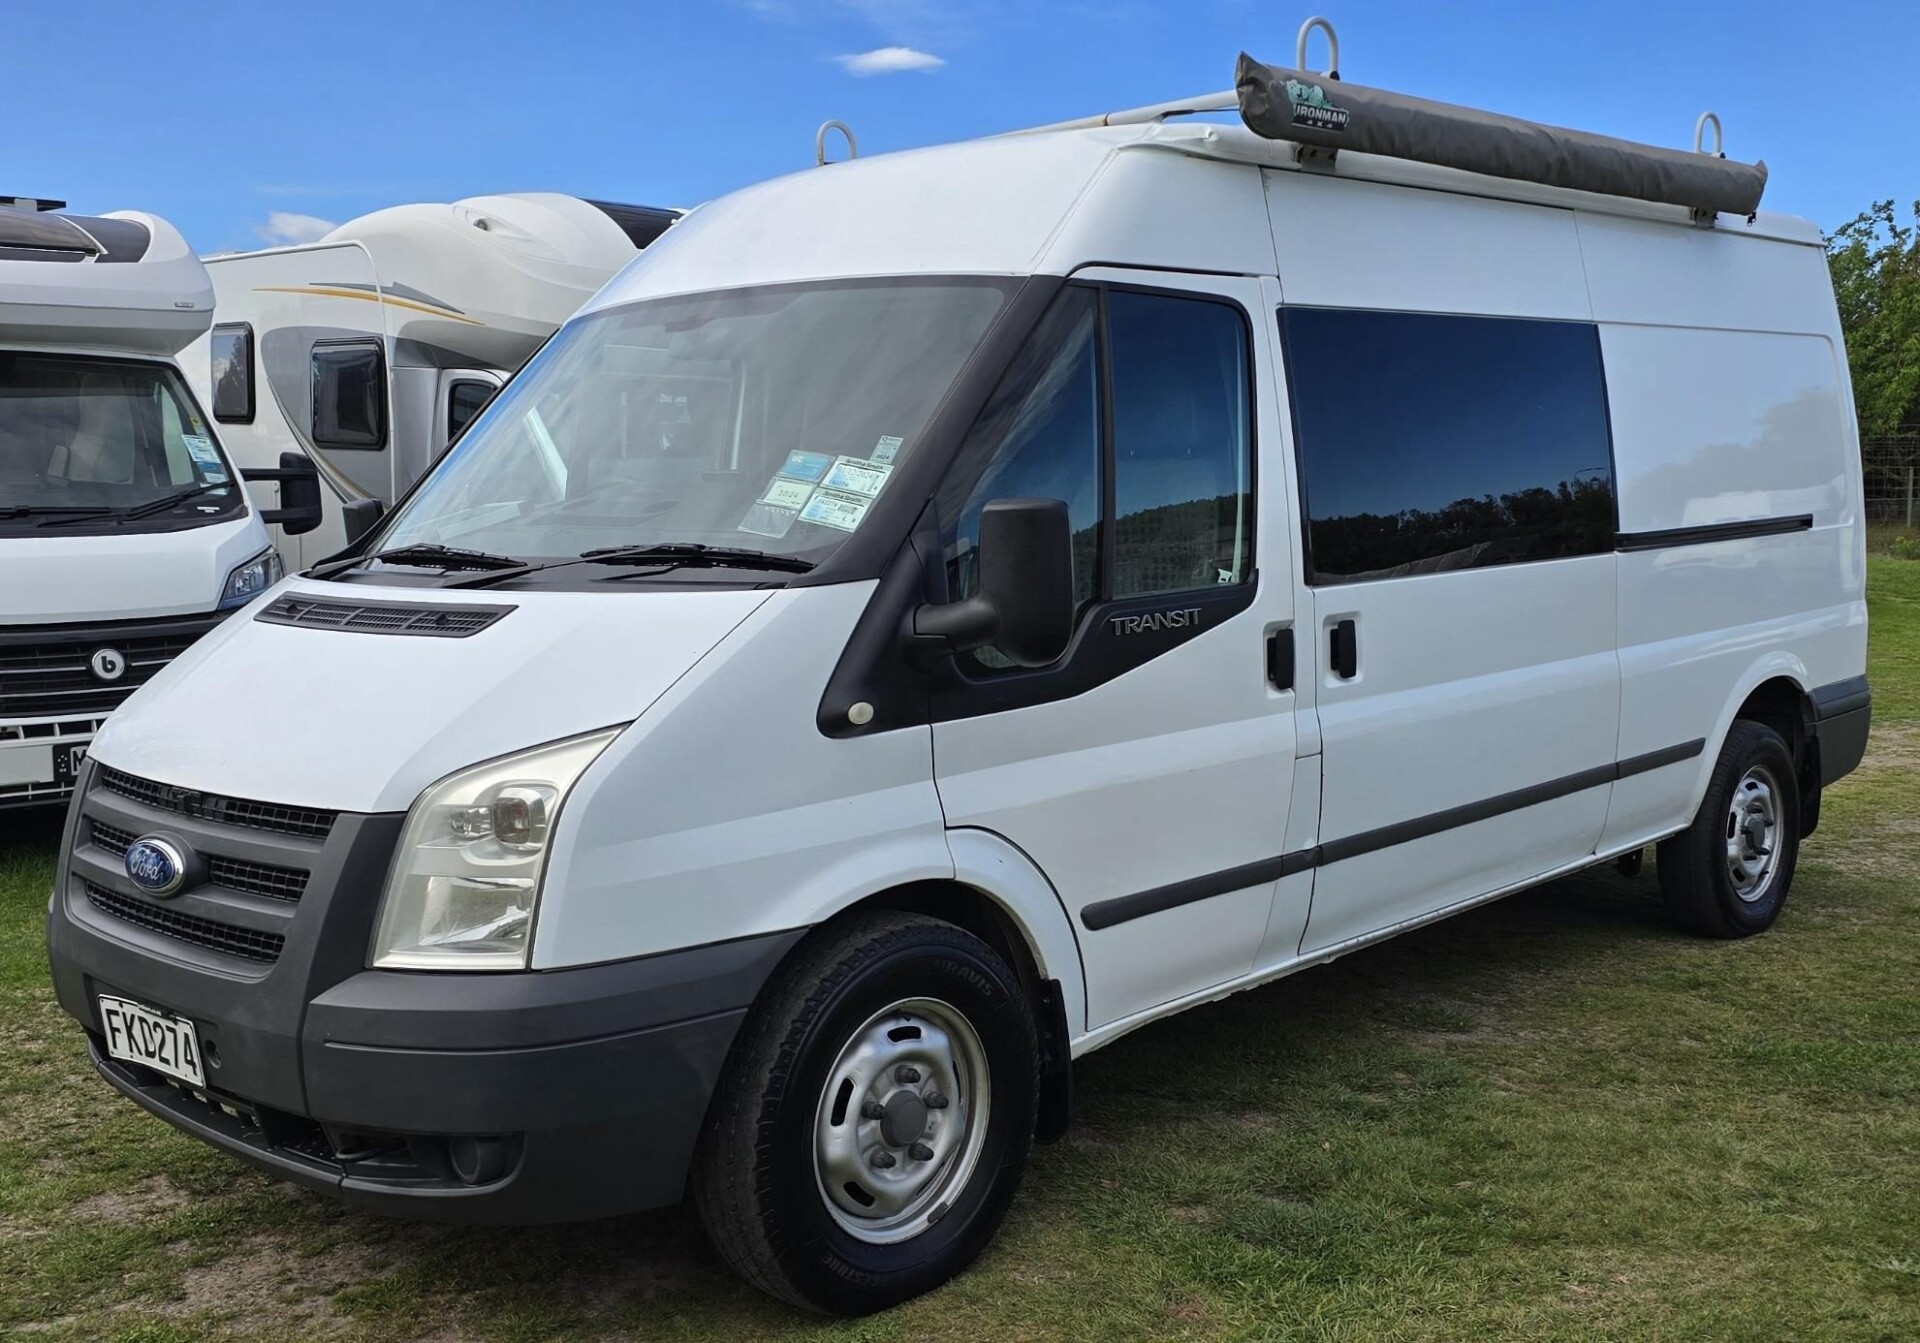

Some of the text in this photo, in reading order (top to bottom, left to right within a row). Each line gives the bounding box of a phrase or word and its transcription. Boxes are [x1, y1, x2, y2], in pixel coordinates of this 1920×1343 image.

[1297, 105, 1346, 123] IRONMAN
[1110, 607, 1202, 636] TRANSIT
[129, 847, 164, 880] Ford
[105, 1008, 198, 1077] FKD274
